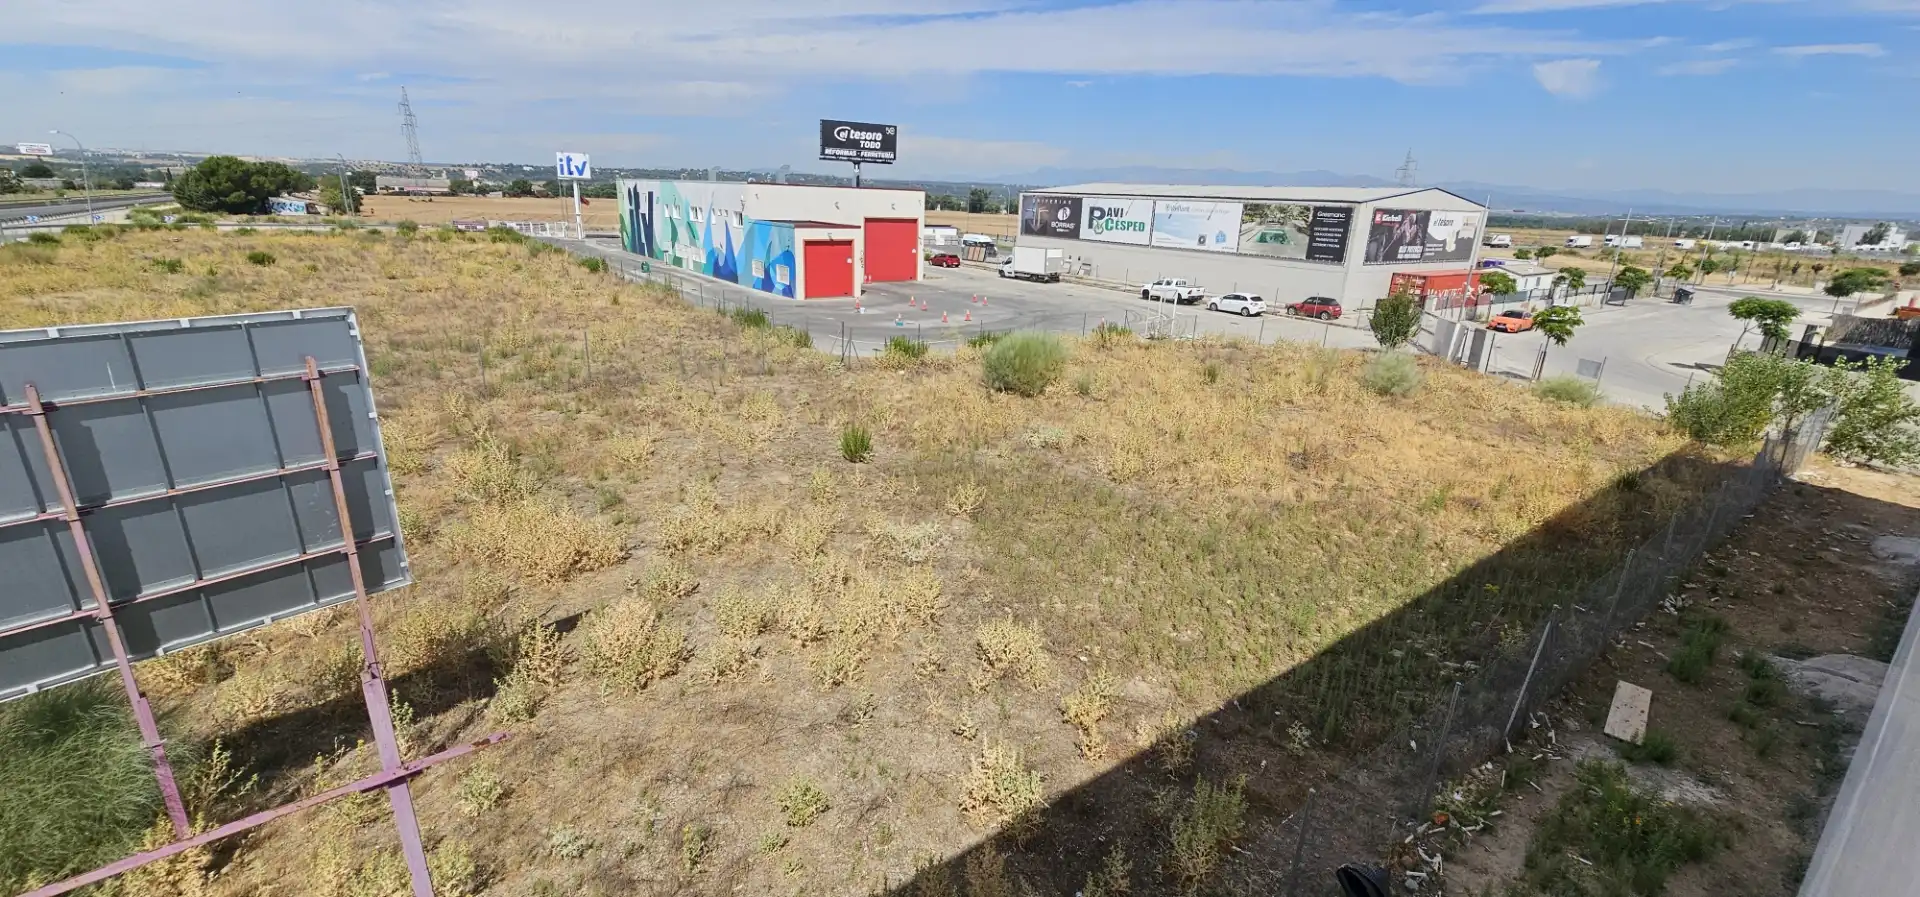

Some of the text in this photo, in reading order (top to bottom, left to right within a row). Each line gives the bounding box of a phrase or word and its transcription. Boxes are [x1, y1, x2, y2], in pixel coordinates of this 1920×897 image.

[850, 129, 883, 141] tesoro
[860, 140, 881, 149] TODO
[824, 148, 857, 157] REFORMAS
[559, 155, 587, 176] itv
[1105, 217, 1146, 232] CESPED
